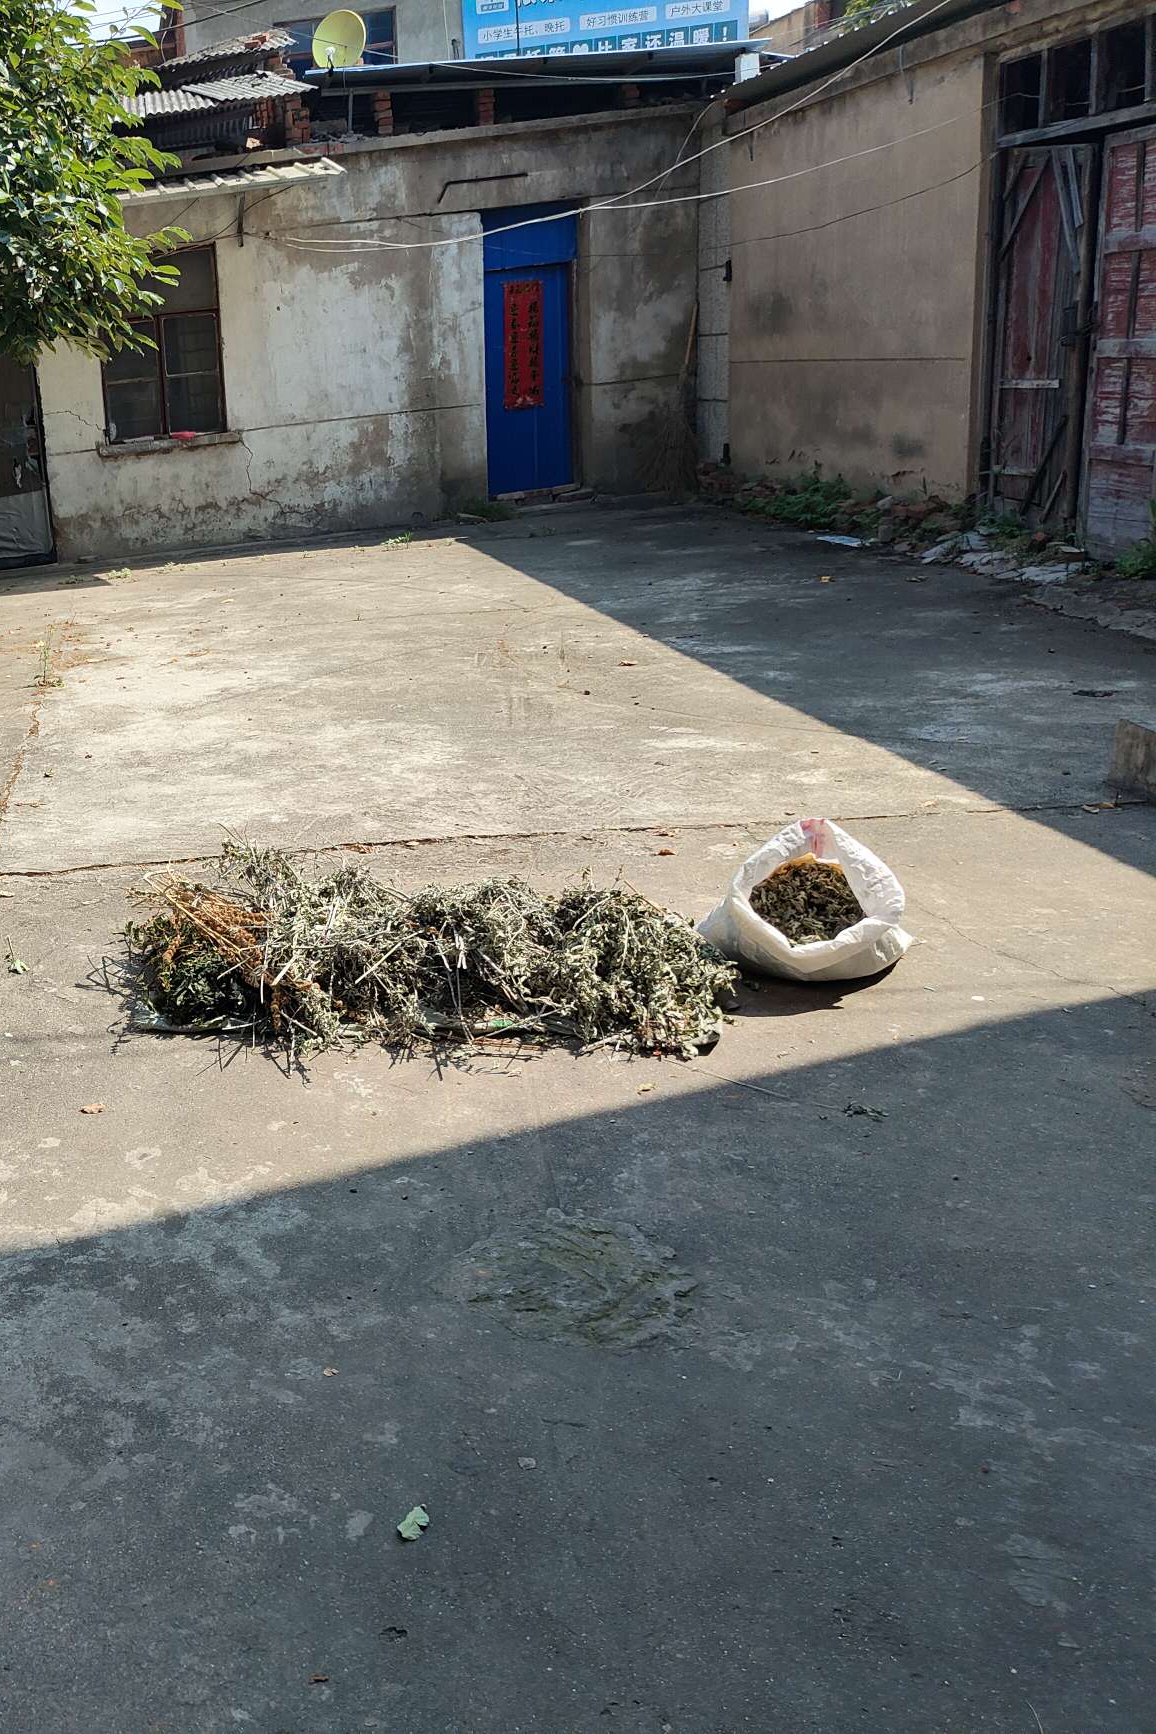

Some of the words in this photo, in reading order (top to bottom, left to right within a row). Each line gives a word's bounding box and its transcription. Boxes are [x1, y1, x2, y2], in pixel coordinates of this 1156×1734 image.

[670, 0, 724, 17] 户外大课堂
[586, 10, 649, 28] 好习惯训练营
